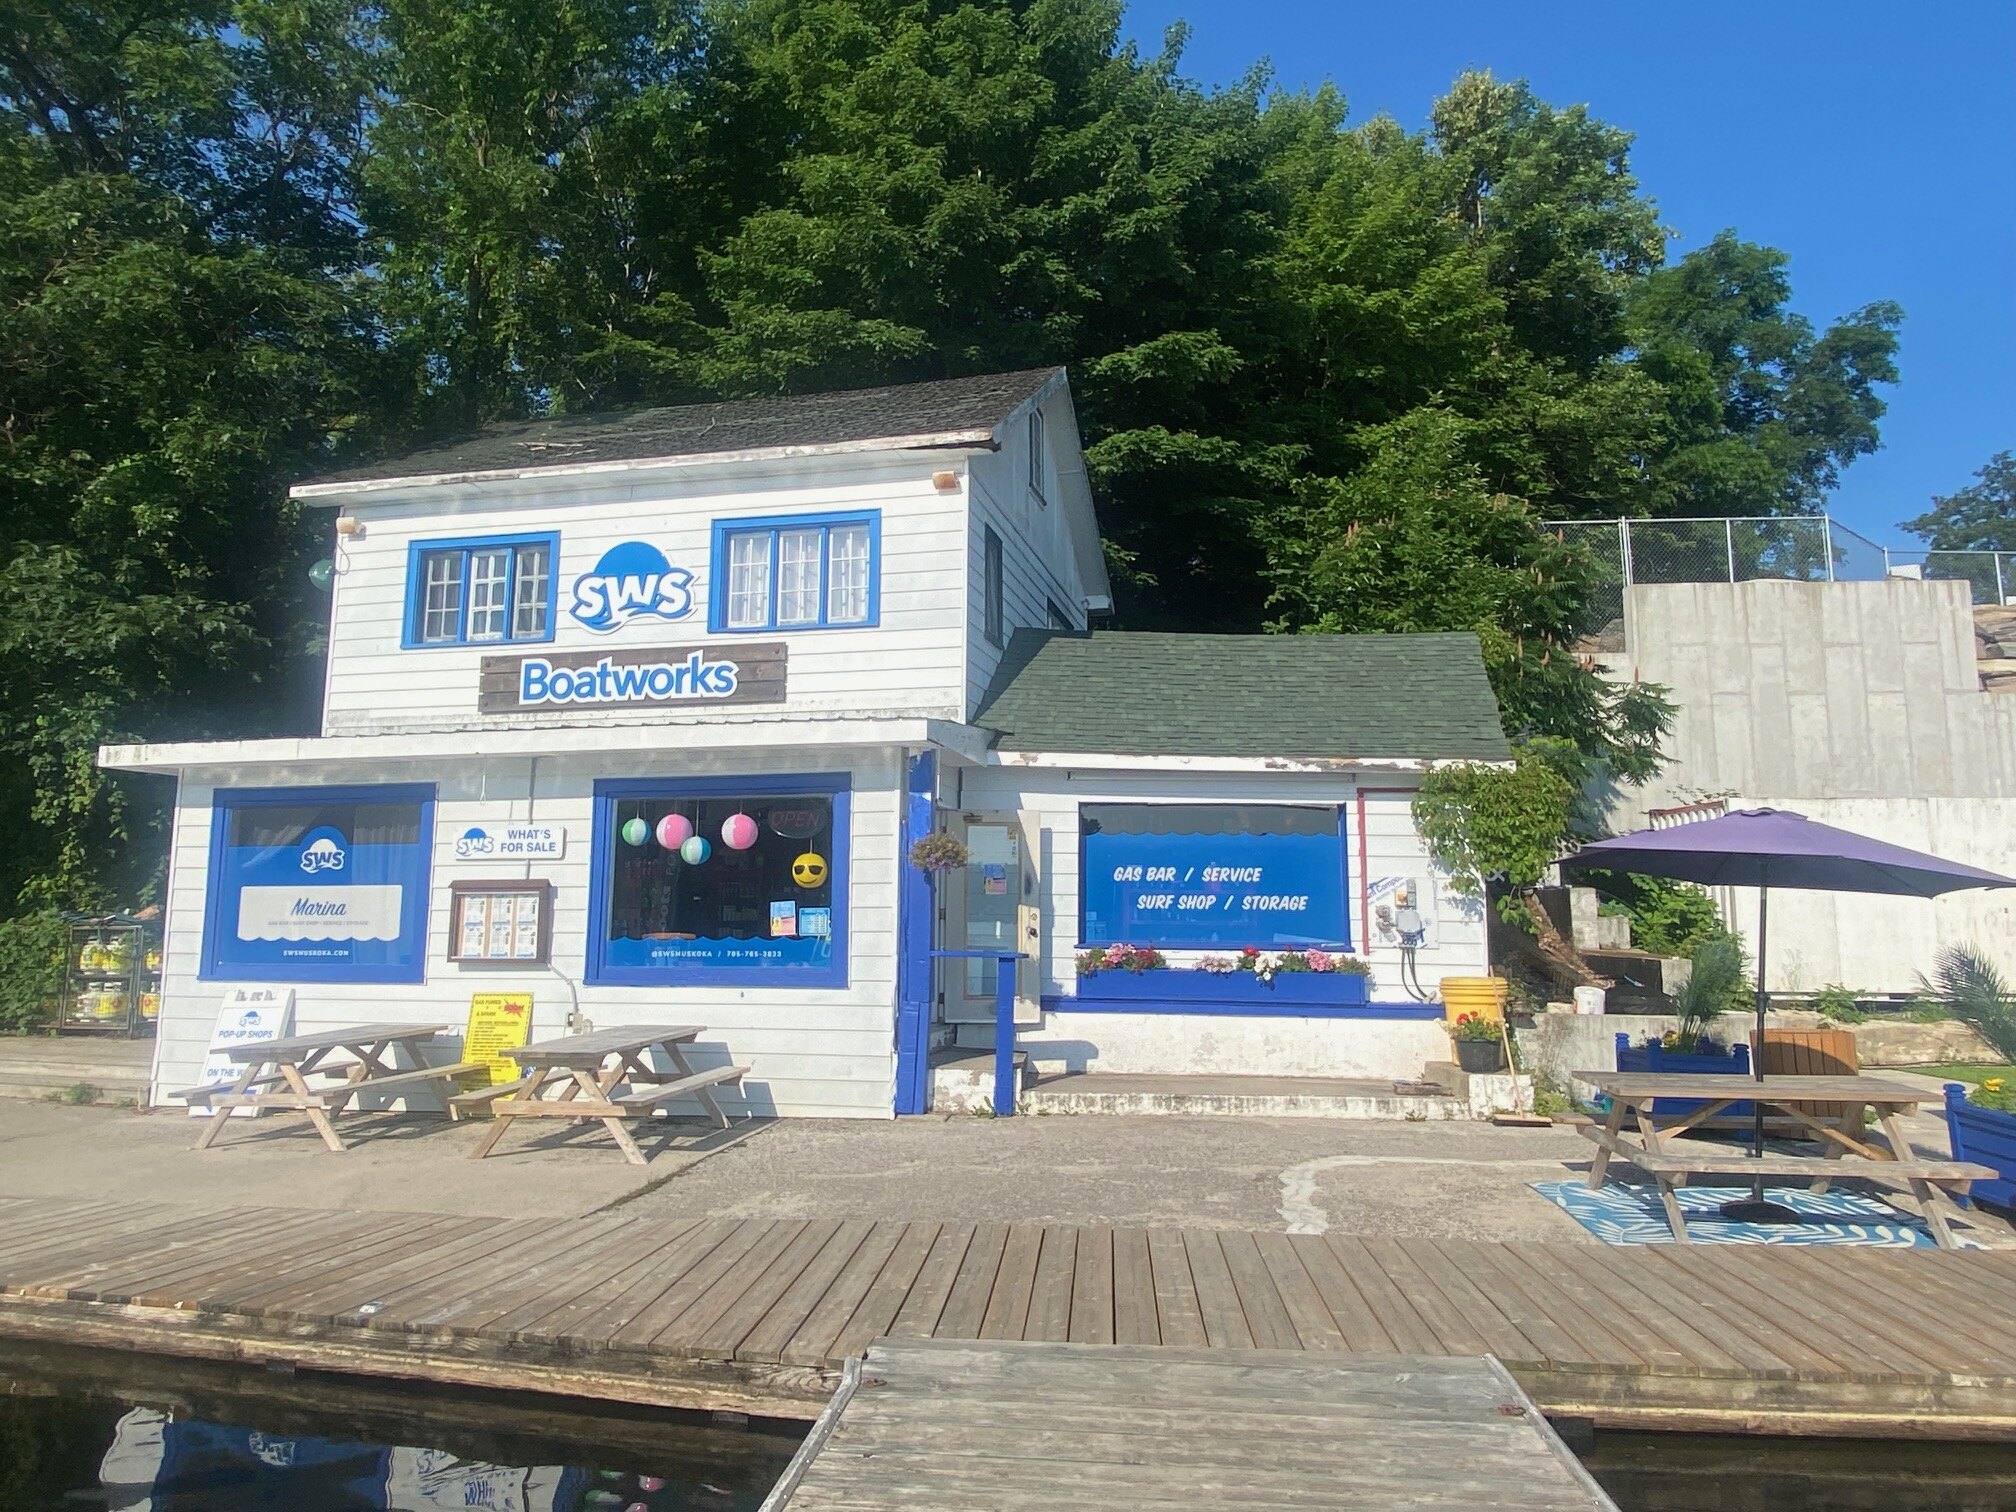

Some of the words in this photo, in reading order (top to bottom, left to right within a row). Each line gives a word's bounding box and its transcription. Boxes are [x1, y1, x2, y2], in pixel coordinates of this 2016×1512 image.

[570, 567, 694, 631] SWS
[520, 653, 737, 702] Boatworks
[771, 810, 819, 827] OPEN
[507, 829, 551, 839] WHAT'S
[456, 837, 494, 856] SWS
[500, 843, 523, 852] FOR
[527, 842, 556, 852] SALE
[301, 850, 345, 872] SWS
[1113, 867, 1143, 882] GAS
[1146, 867, 1176, 882] BAR
[1202, 867, 1263, 883] SERVICE
[290, 897, 347, 916] Marina
[1137, 895, 1175, 910] SURF
[1177, 895, 1216, 910] SHOP
[1242, 896, 1309, 911] STORAGE
[218, 1030, 246, 1038] POP-UP
[247, 1030, 273, 1038] SHOPS
[207, 1068, 220, 1077] ON
[220, 1068, 236, 1077] THE
